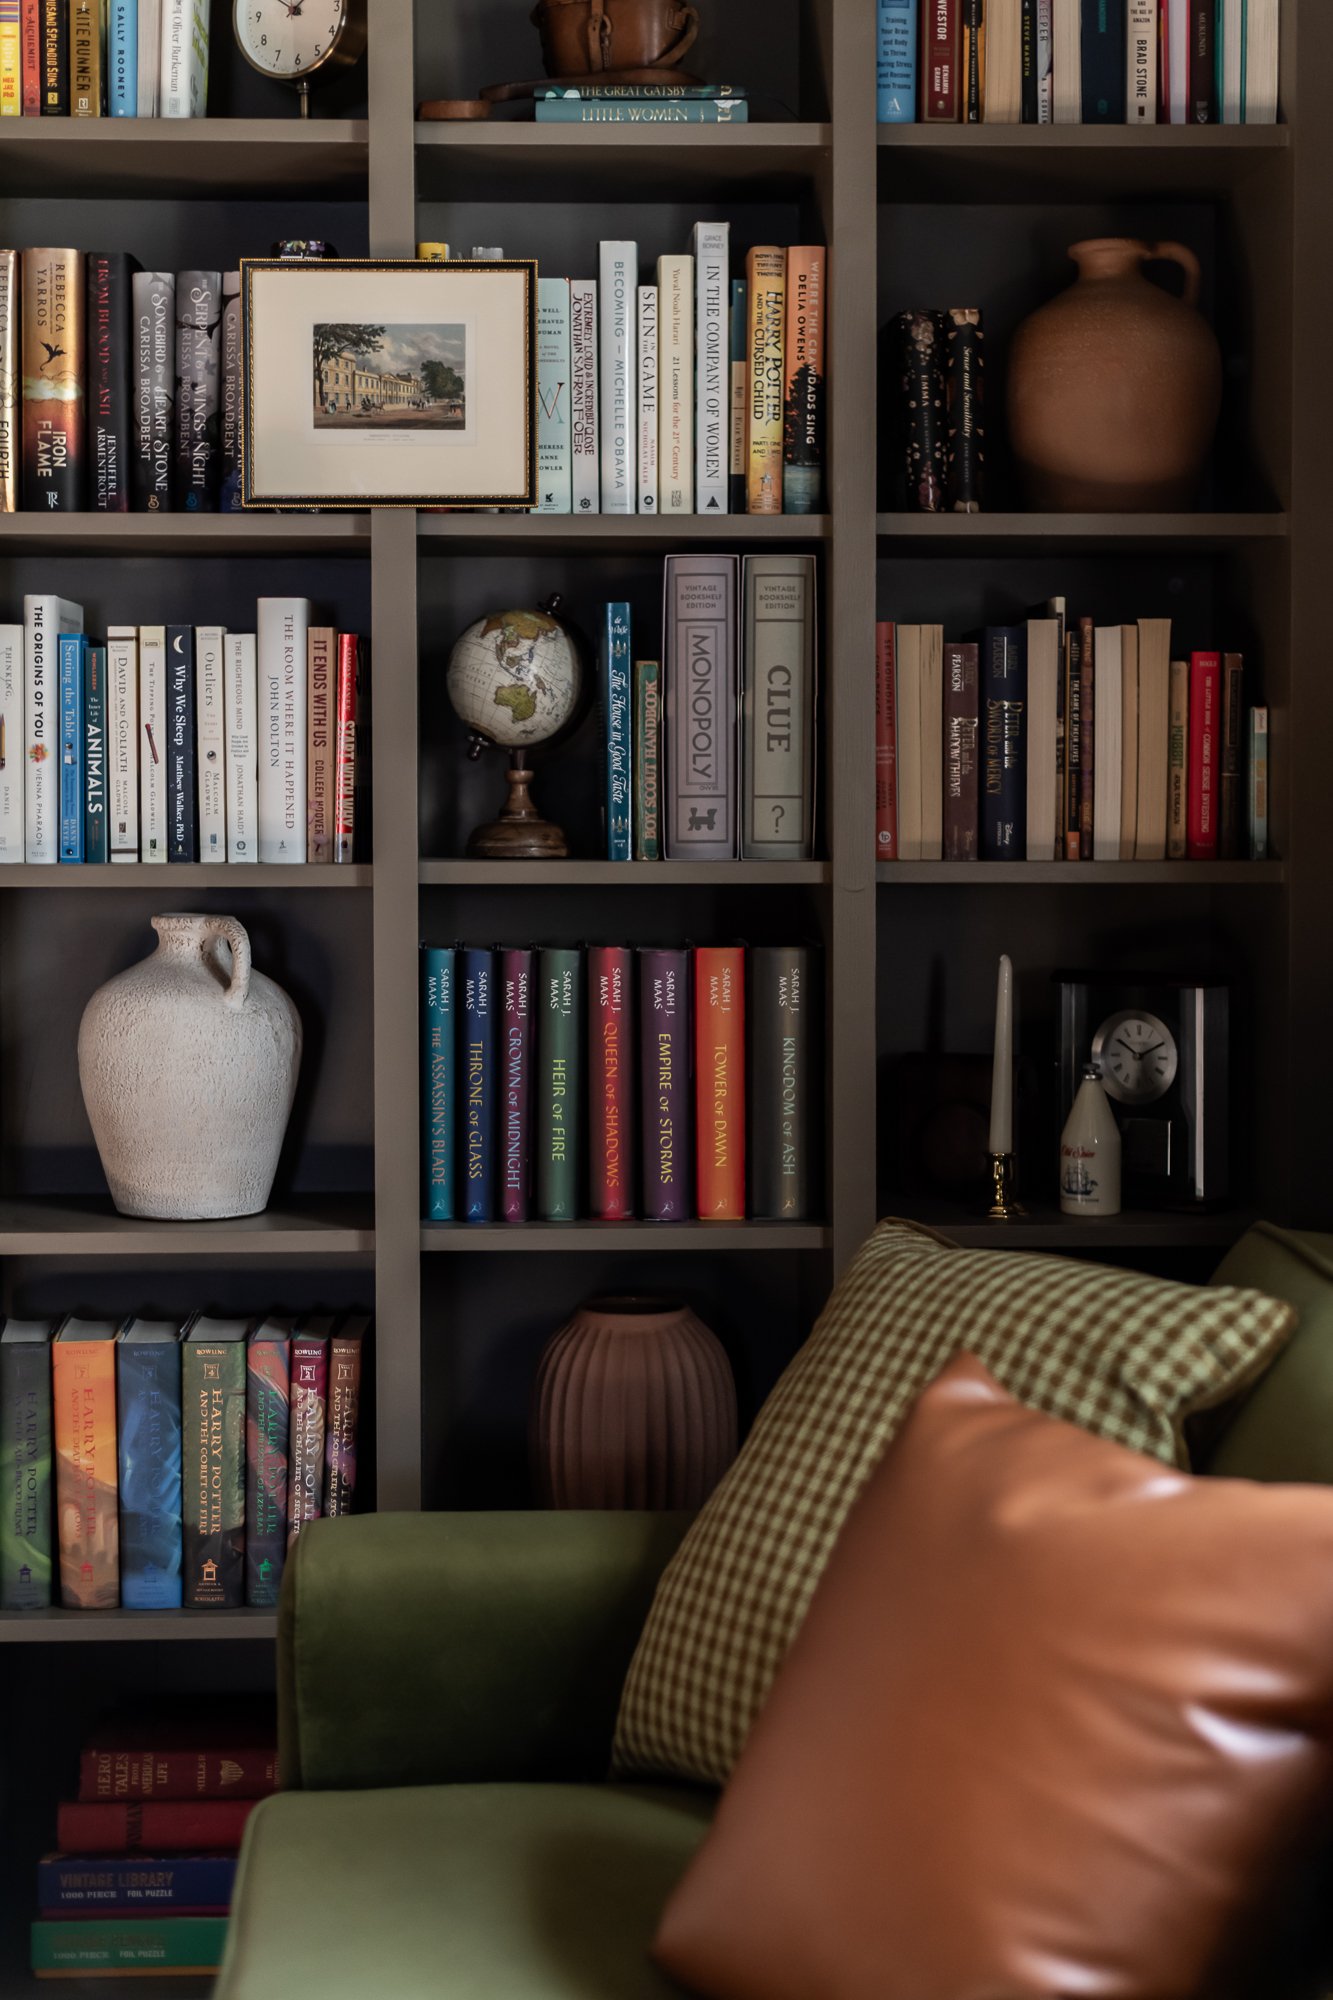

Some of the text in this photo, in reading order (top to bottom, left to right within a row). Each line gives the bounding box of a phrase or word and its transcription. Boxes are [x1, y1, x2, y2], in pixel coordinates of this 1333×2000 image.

[256, 11, 261, 23] 9
[329, 24, 336, 36] 4
[334, 0, 340, 12] 3
[76, 8, 90, 91] KITE RUNNER
[171, 16, 182, 92] Oliver Burkeman
[261, 35, 267, 46] 8
[274, 50, 281, 61] 7
[294, 53, 301, 64] 6
[314, 45, 321, 56] 5
[1136, 39, 1147, 98] BRAD STONE
[581, 86, 687, 97] THE GREAT GATSBY
[582, 108, 688, 121] LITTLE WOMEN
[37, 269, 47, 327] YARROS
[56, 264, 65, 332] REBECCA
[797, 275, 806, 361] DELIA OWENS
[573, 293, 584, 455] JONATHAN SAFRAN FOER
[614, 262, 624, 488] BECOMING MICHELLE OBAMA
[643, 292, 655, 413] SKIN GAME
[706, 266, 720, 478] IN THE COMPANY OF WOMEN
[766, 291, 783, 422] HARRY POTTER
[141, 316, 150, 461] CARISSA BROADBENT
[181, 314, 192, 457] CARISSA BROADBENT
[225, 313, 237, 457] CARISSA BROADBENT
[921, 375, 929, 407] EMMA
[963, 346, 973, 438] Sense and Sensibility
[37, 421, 52, 477] FLAME
[53, 431, 66, 467] IRON
[97, 427, 106, 509] ARMENTROUT
[34, 606, 43, 738] THE ORIGINS OF YOU
[204, 652, 216, 706] Outliers
[313, 641, 327, 747] IT ENDS WITH US
[952, 654, 961, 692] PEARSON
[174, 665, 186, 745] Why We Sleep
[268, 675, 279, 767] JOHN BOLTON
[284, 615, 294, 829] THE ROOM WHERE IT HAPPENED
[692, 634, 712, 778] MONOPOLY
[767, 665, 792, 752] CLUE
[88, 724, 102, 813] ANIMALS
[315, 760, 324, 834] COLLEEN HOOVER
[429, 977, 437, 1006] MAAS
[441, 969, 449, 1004] SARAH
[466, 980, 474, 1010] MAAS
[479, 972, 487, 1006] SARAH
[506, 981, 514, 1011] MAAS
[517, 973, 527, 1019] SARAH J.
[551, 979, 559, 1009] MAAS
[563, 971, 571, 1006] SARAH
[600, 975, 609, 1006] MAAS
[612, 968, 621, 1003] SARAH
[654, 979, 662, 1009] MAAS
[666, 971, 675, 1006] SARAH
[710, 976, 718, 1006] MAAS
[778, 976, 787, 1007] MAAS
[432, 1027, 445, 1185] THE ASSASSIN'S BLADE
[469, 1041, 483, 1179] THRONE OF GLASS
[507, 1027, 522, 1190] CROWN OF MIDNIGHT
[552, 1059, 566, 1161] HEIR OF FIRE
[604, 1023, 619, 1187] QUEEN OF SHADOWS
[658, 1034, 673, 1184] EMPIRE OF STORMS
[714, 1044, 727, 1166] TOWER OF DAWN
[782, 1037, 795, 1175] KINGDOM OF ASH
[342, 1387, 353, 1453] HARRY
[26, 1392, 37, 1535] HARRY POTTER
[200, 1448, 208, 1488] GOBLET
[210, 1389, 224, 1535] HARRY POTTER
[200, 1491, 208, 1505] OF
[98, 1753, 111, 1795] HERO
[115, 1753, 129, 1795] TALES
[131, 1763, 139, 1785] FROM
[142, 1752, 154, 1795] AMERICAN
[156, 1762, 168, 1784] LIFE
[197, 1754, 206, 1791] MILLER
[60, 1872, 173, 1887] VINTAGE LIBRARY
